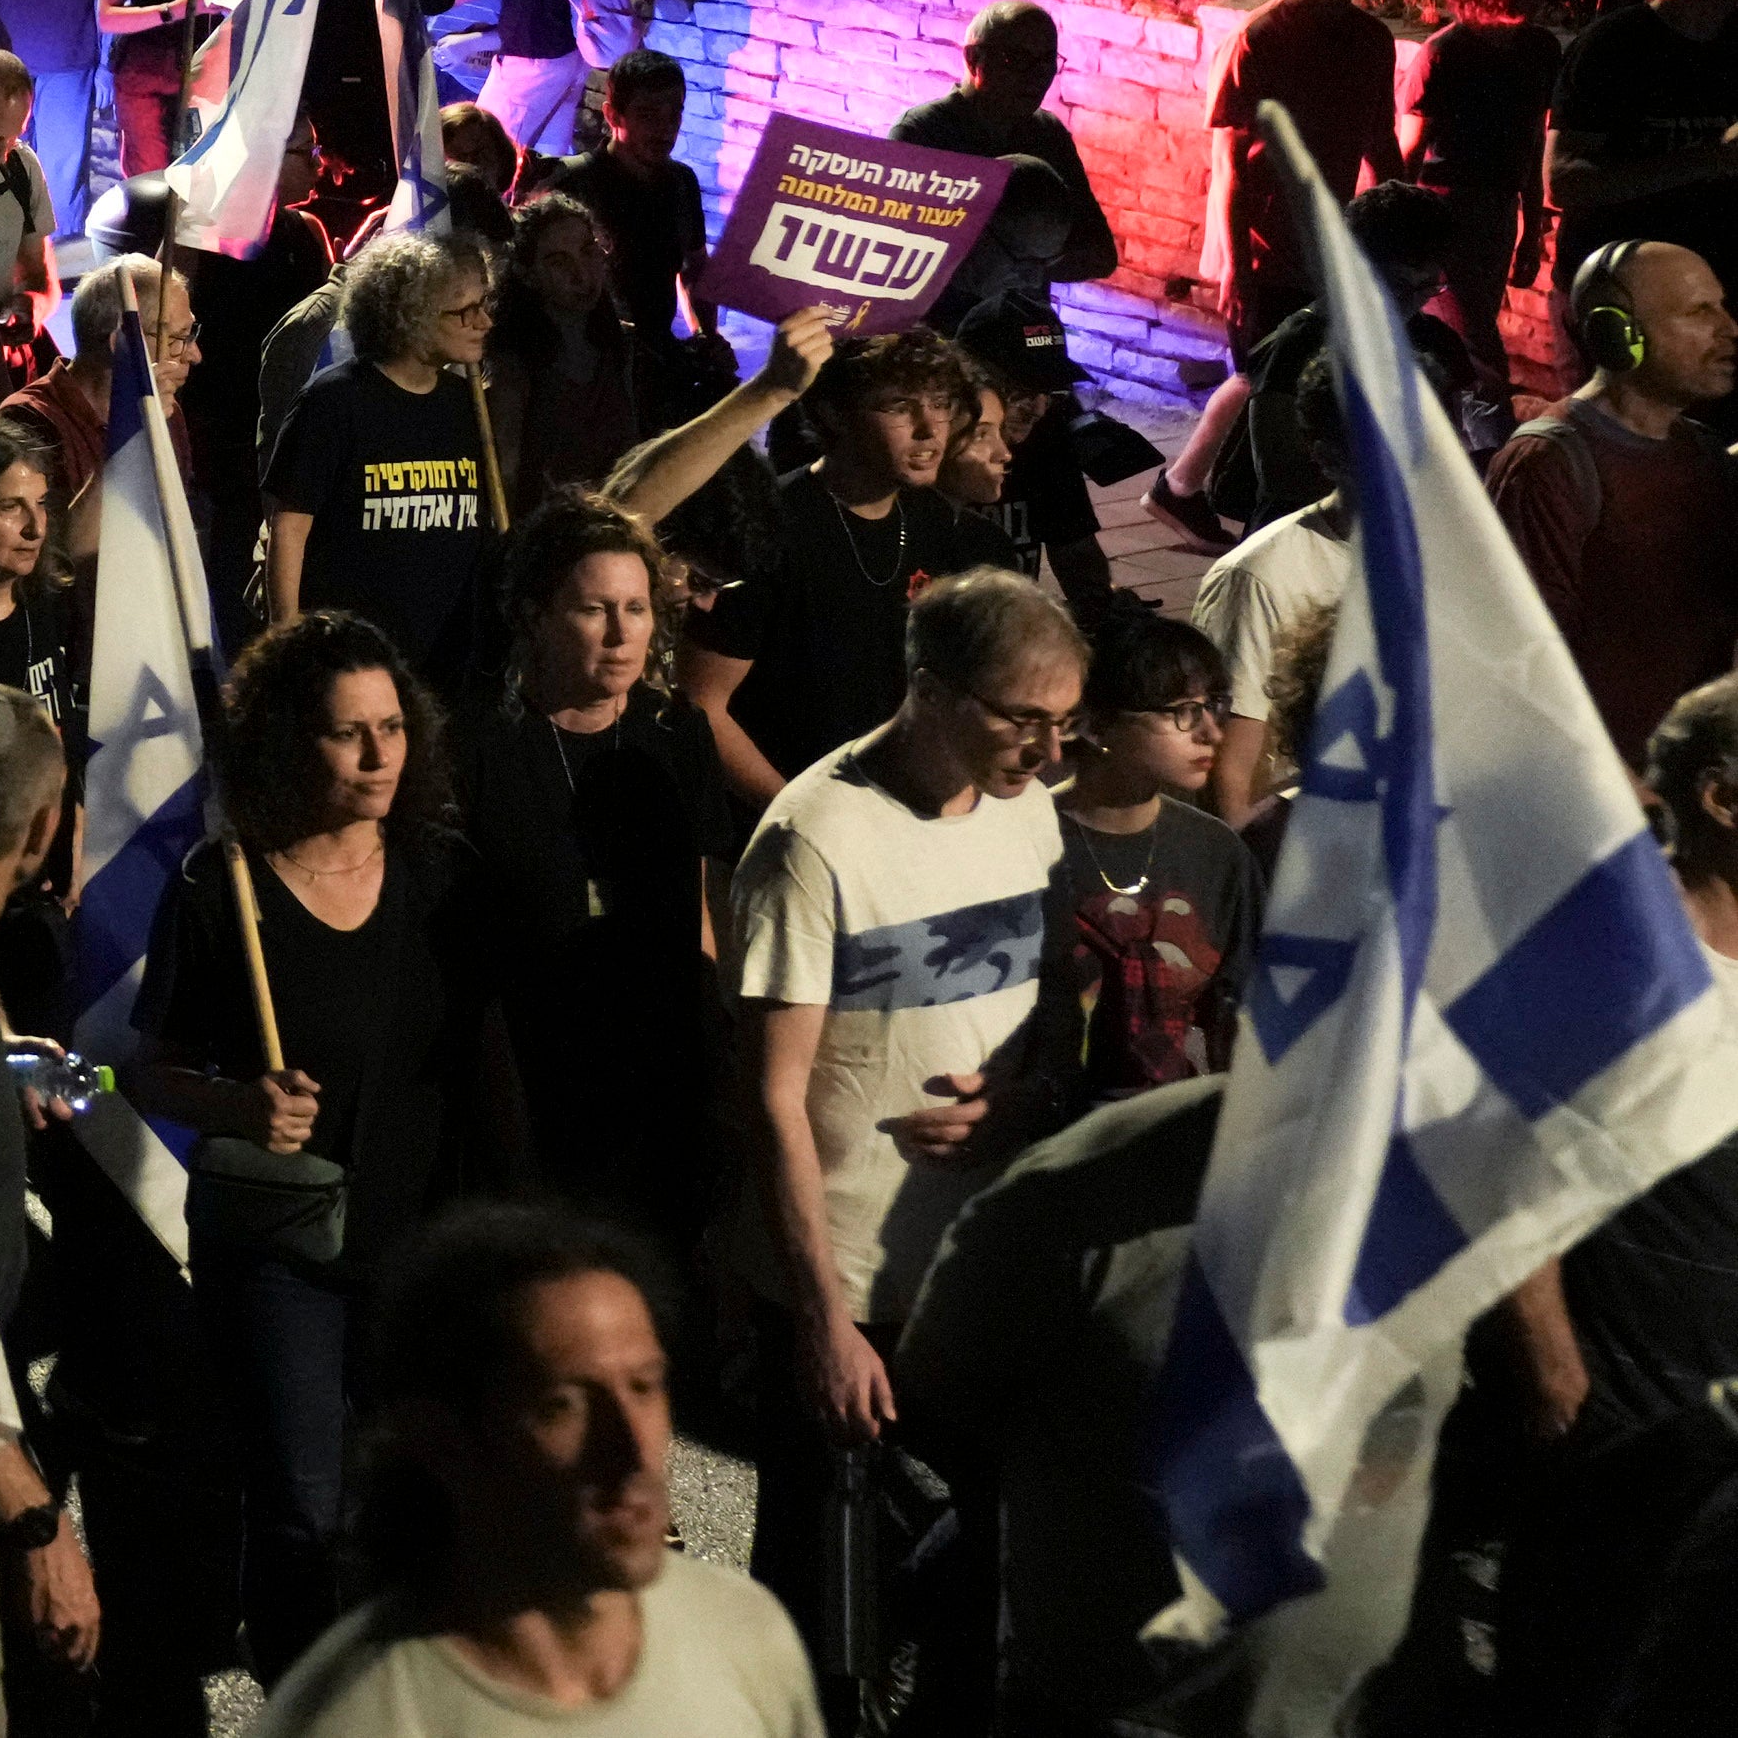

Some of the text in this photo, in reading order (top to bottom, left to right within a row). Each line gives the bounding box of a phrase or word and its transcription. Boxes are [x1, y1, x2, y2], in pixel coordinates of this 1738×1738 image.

[777, 172, 967, 229] לעצור את המלחמה
[787, 142, 981, 204] לקבל את העסקה
[774, 211, 936, 291] עכשיו
[364, 460, 457, 492] דמוקרטיה
[362, 494, 479, 532] אין אקדמיה
